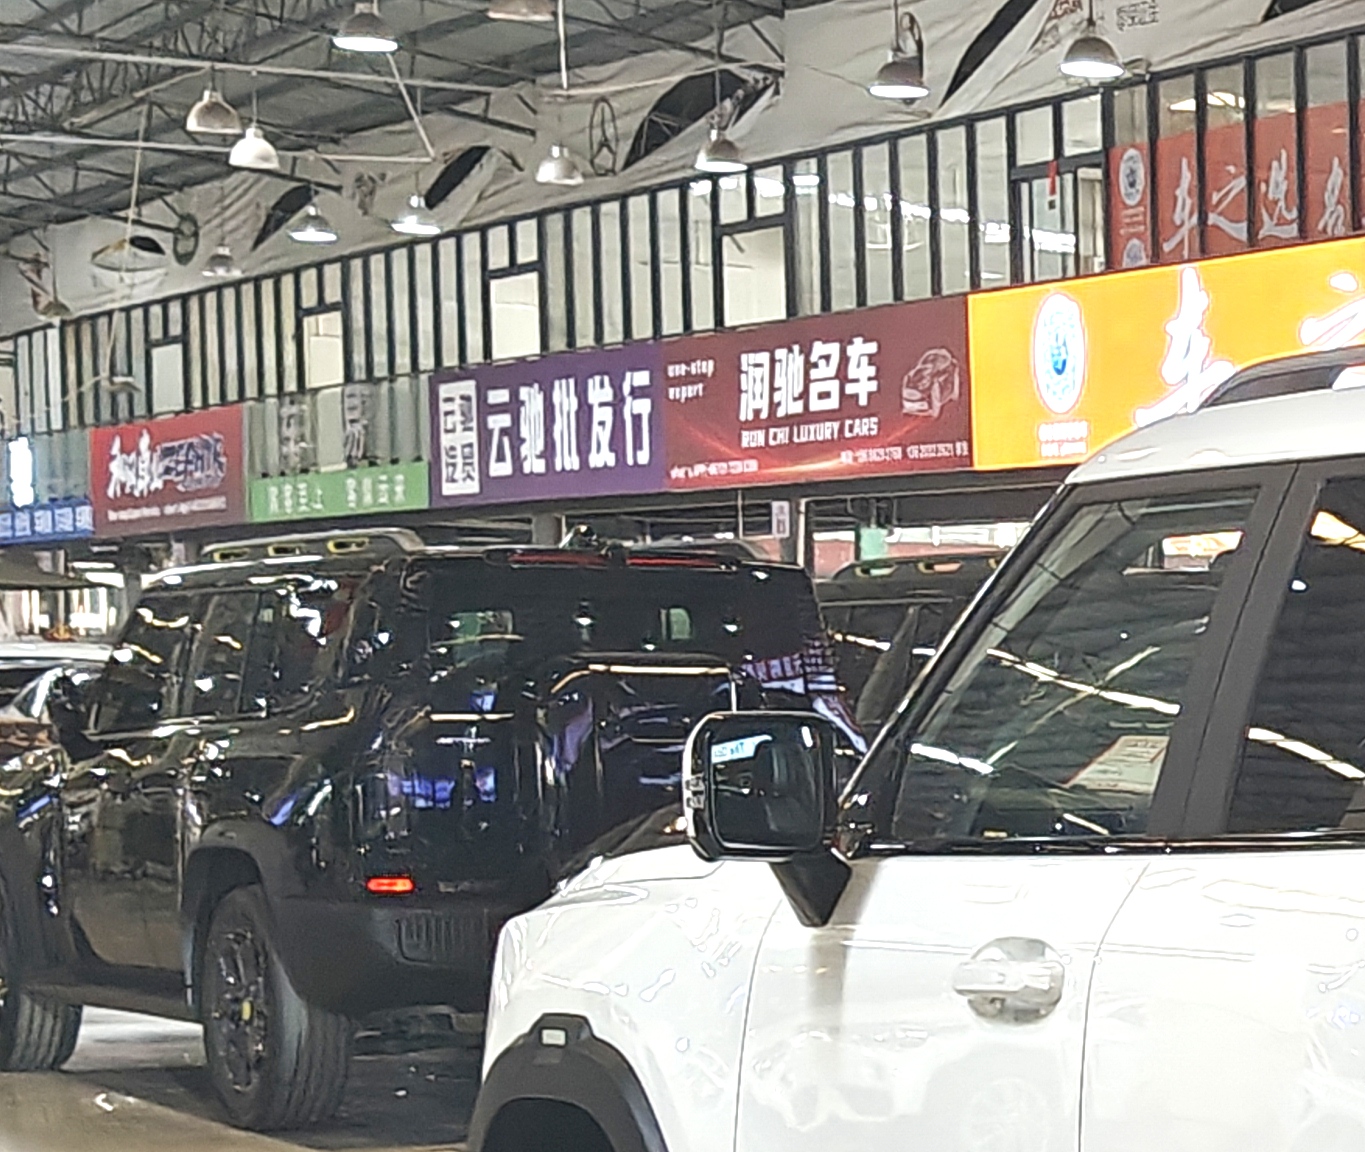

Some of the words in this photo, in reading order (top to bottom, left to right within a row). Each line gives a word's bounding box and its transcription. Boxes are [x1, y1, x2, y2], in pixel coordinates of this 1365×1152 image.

[739, 337, 879, 421] 润驰名车
[486, 370, 652, 477] 云驰批发行
[793, 421, 841, 443] LUXURY
[844, 416, 879, 438] CARS
